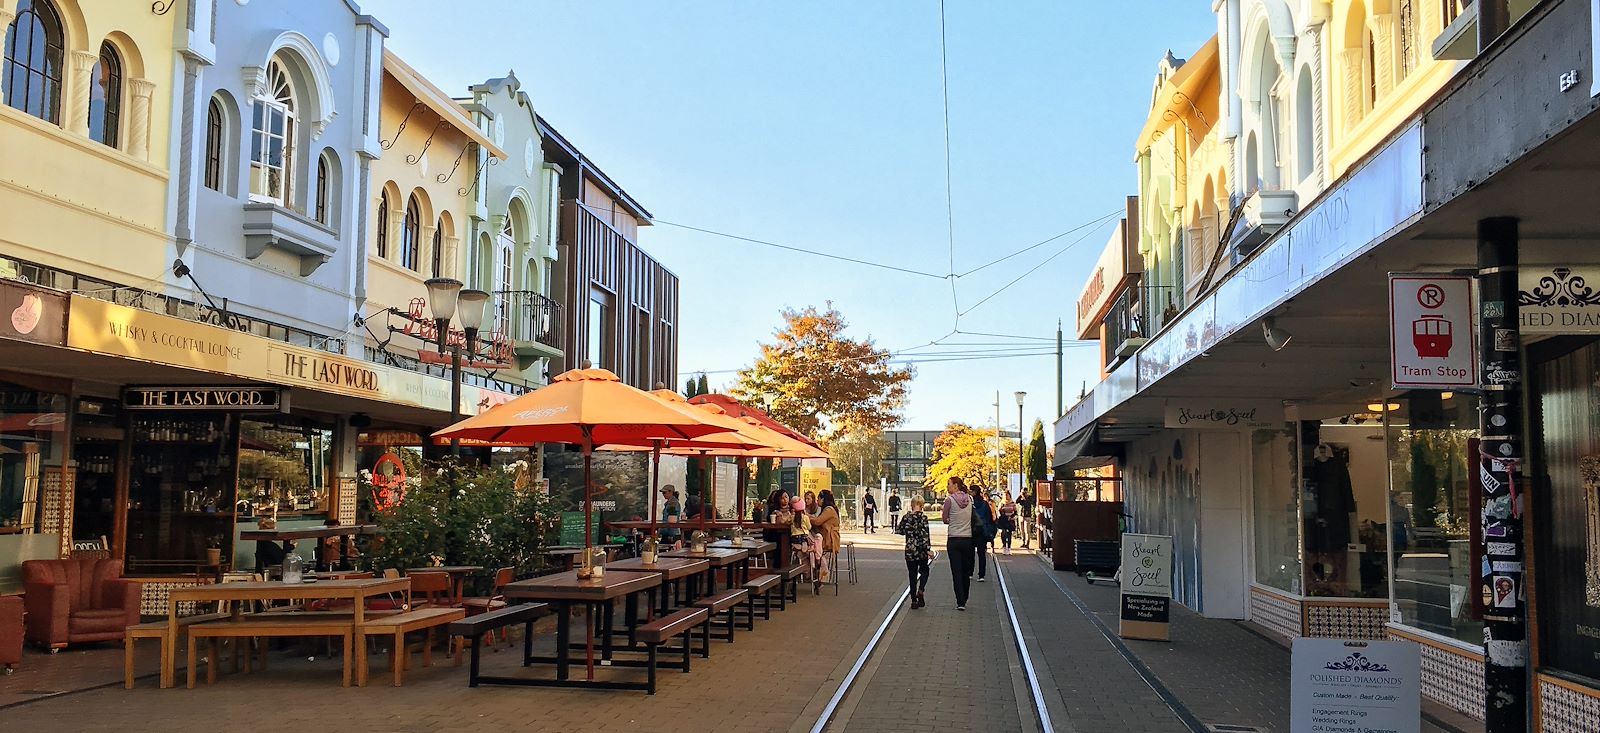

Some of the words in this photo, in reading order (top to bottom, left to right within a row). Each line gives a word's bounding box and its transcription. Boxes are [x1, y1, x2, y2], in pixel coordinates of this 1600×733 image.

[109, 321, 148, 341] WHISKY
[152, 330, 158, 344] &
[161, 333, 206, 353] COCKTAIL
[208, 342, 242, 360] LOUNGE
[283, 352, 308, 379] THE
[312, 359, 342, 385] LAST
[344, 365, 379, 392] WORD.
[1401, 365, 1431, 376] Tram
[1437, 366, 1467, 379] Stop
[141, 391, 168, 406] THE
[174, 391, 210, 406] LAST
[213, 391, 264, 406] WORD.
[1178, 407, 1218, 425] Heart
[1226, 407, 1257, 426] Soul
[1132, 542, 1162, 558] Heart
[1132, 567, 1162, 587] Soul
[1310, 674, 1352, 684] POLISHED
[1354, 676, 1403, 686] DIAMONDS
[1312, 692, 1334, 700] Custom
[1311, 708, 1349, 717] Engagement
[1311, 717, 1338, 725] Wedding
